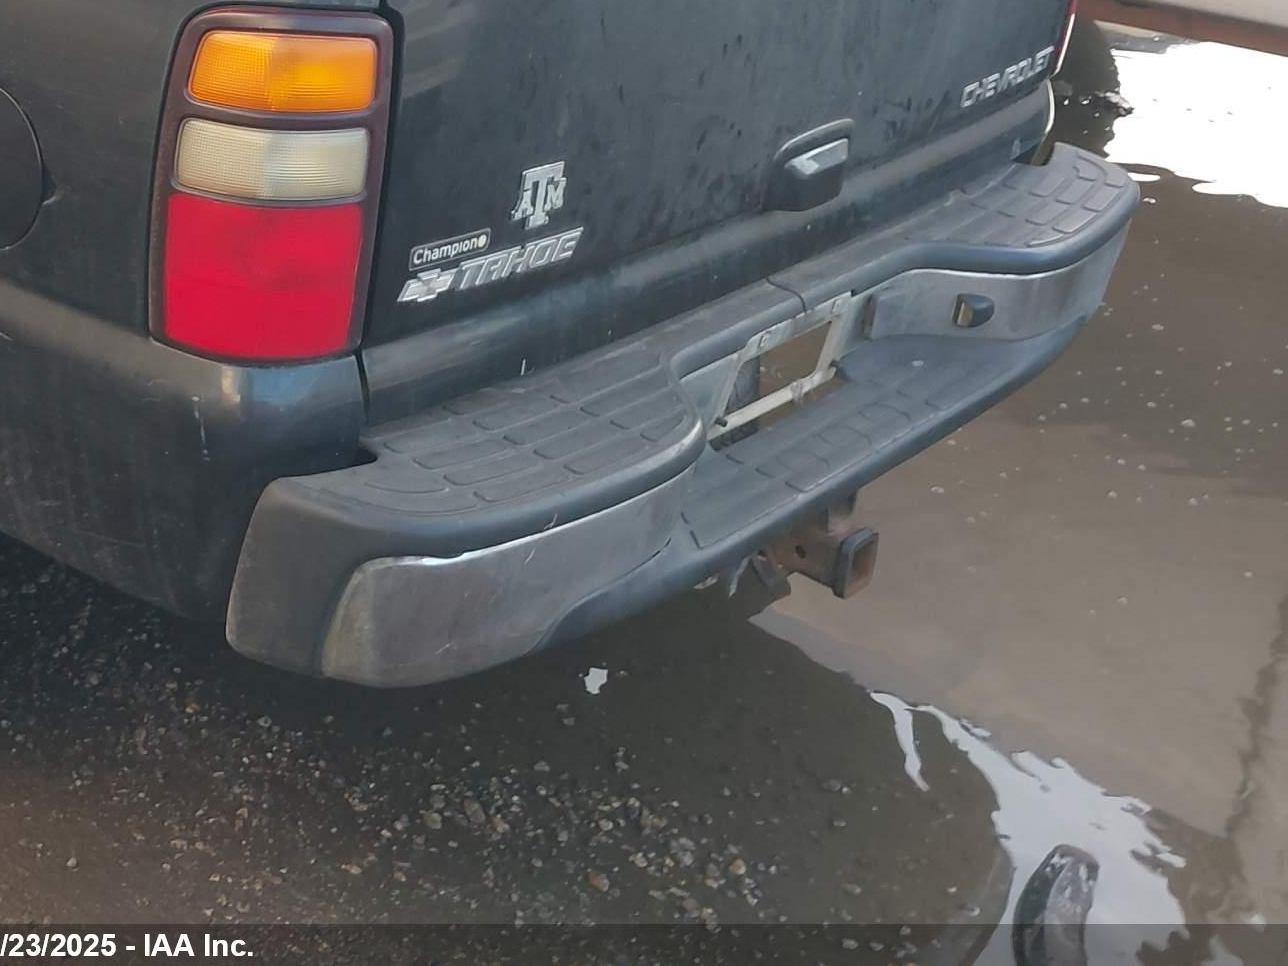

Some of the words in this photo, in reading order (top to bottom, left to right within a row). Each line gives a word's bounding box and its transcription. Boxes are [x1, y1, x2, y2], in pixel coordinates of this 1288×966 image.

[960, 45, 1054, 107] CHEVROLET
[413, 236, 478, 264] Champion
[455, 227, 584, 290] TAHOE
